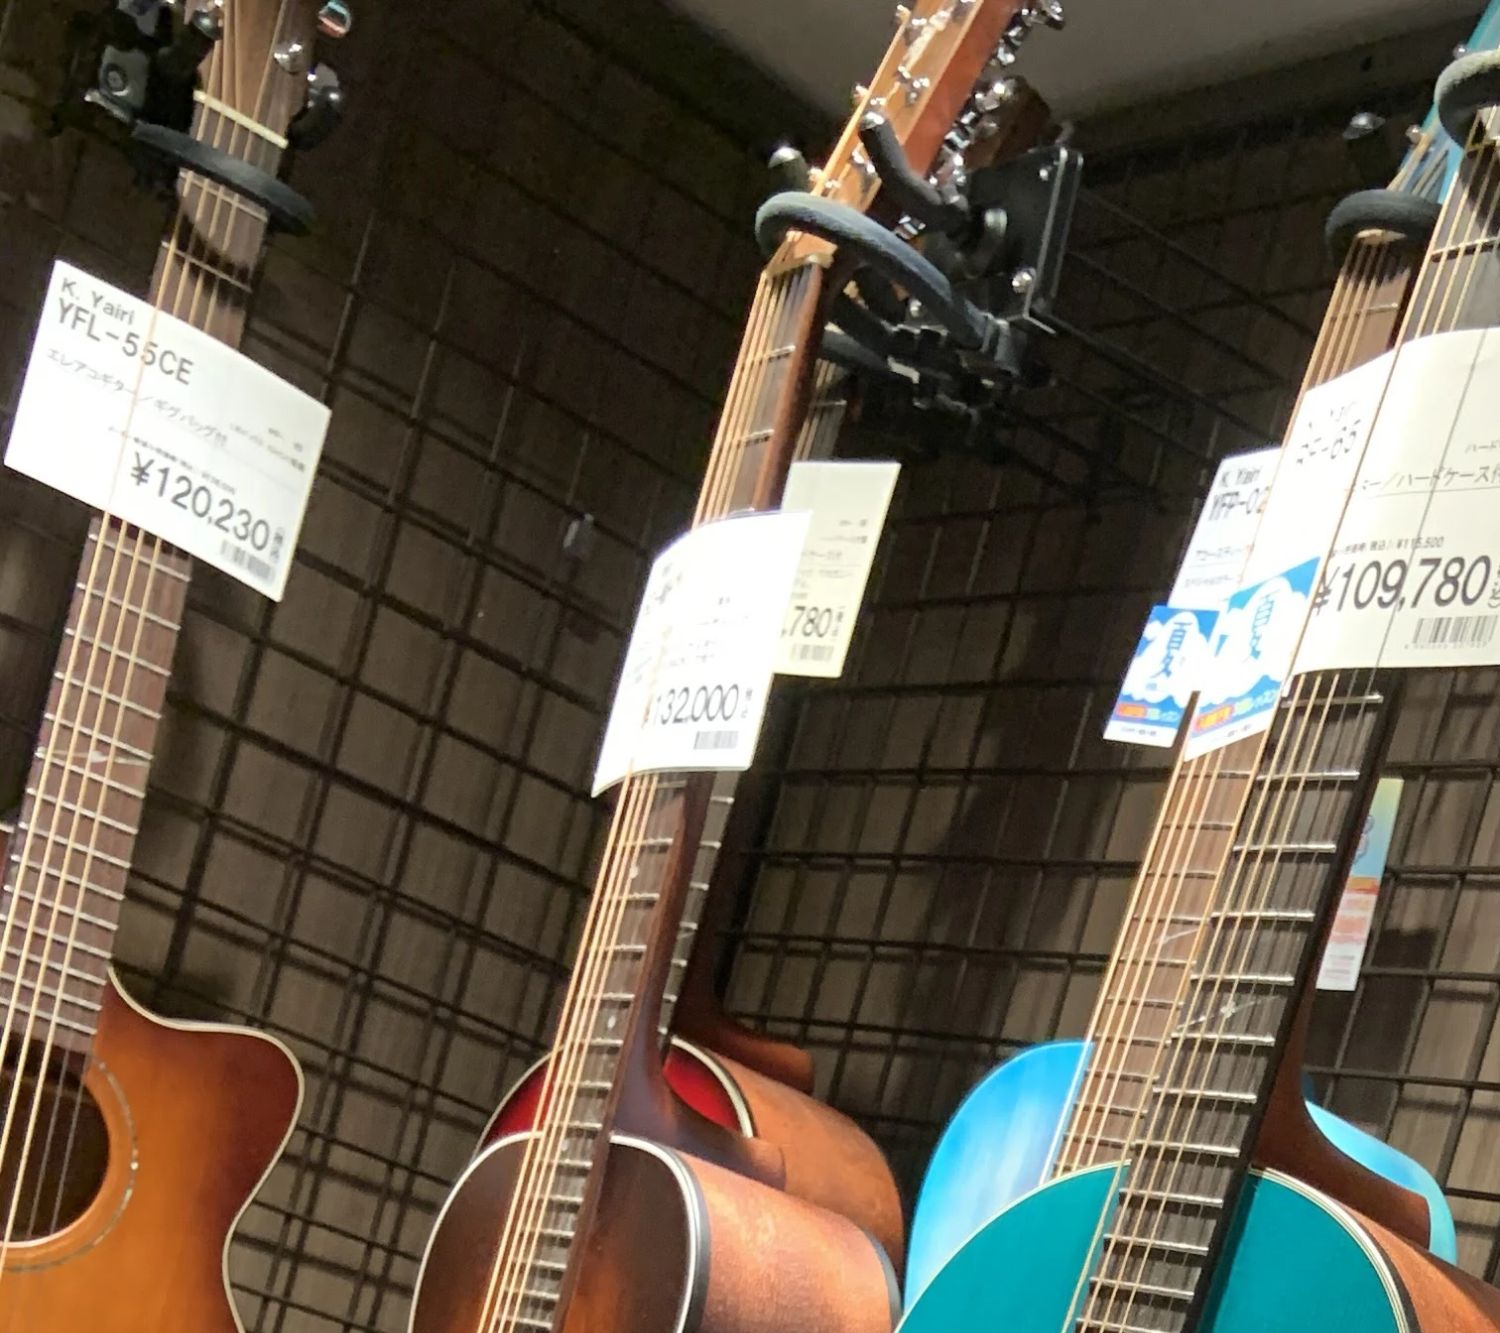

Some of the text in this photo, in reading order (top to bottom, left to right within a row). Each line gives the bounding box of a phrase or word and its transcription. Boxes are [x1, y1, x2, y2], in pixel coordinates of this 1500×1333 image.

[57, 296, 195, 386] YFL-55CE
[131, 450, 271, 553] ¥120,230
[1314, 555, 1492, 617] ¥109,780
